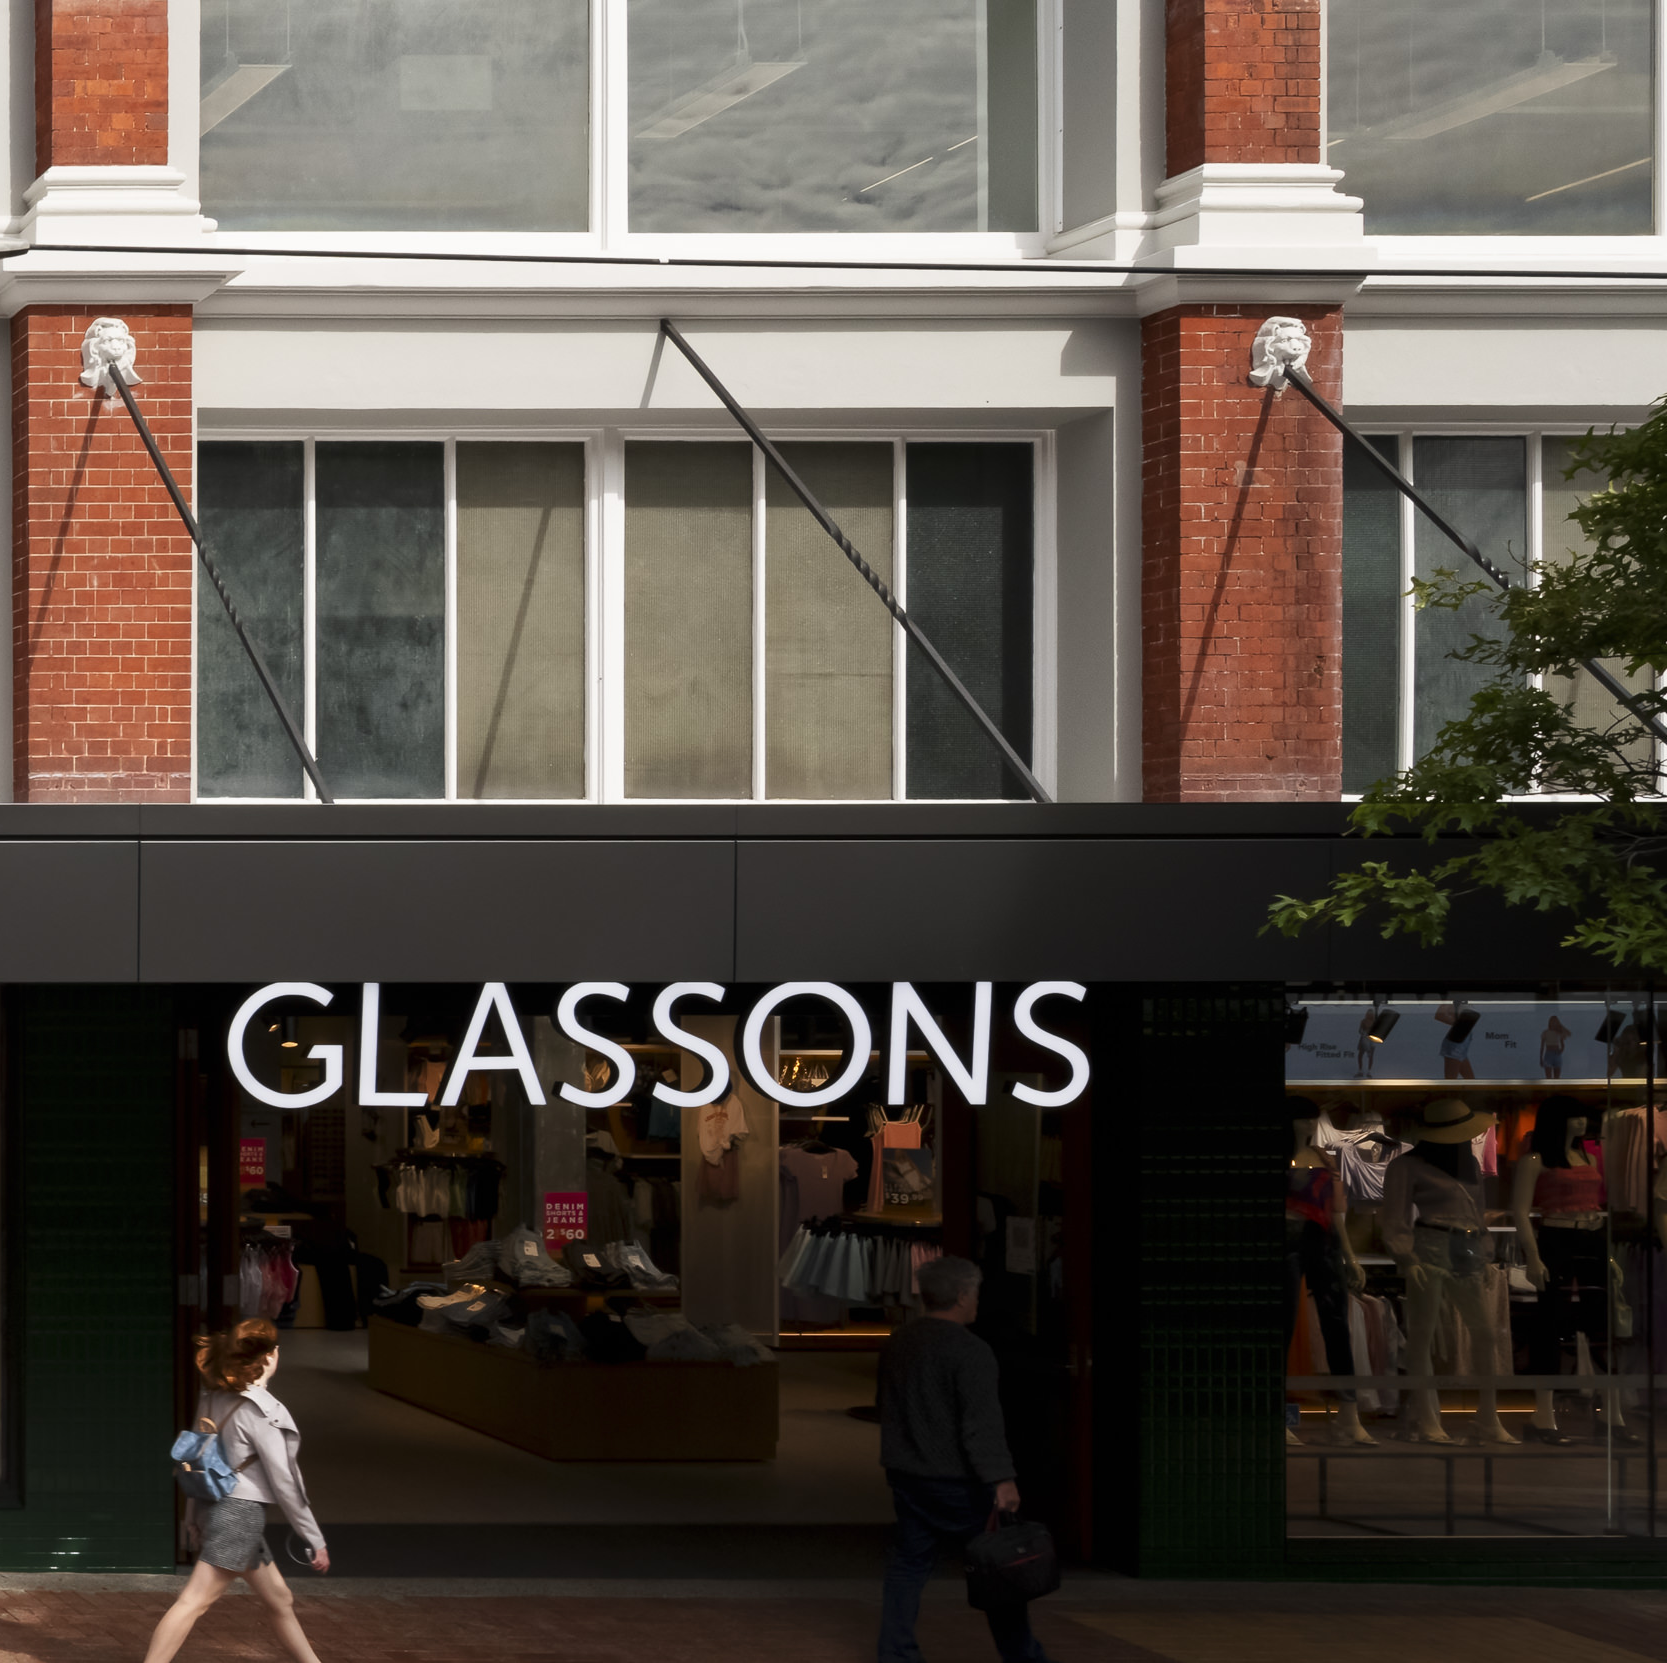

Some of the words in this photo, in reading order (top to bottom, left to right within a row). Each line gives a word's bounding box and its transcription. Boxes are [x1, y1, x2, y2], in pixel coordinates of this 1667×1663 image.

[1485, 1032, 1509, 1040] Mom
[228, 981, 1091, 1108] GLASSONS
[1505, 1041, 1517, 1049] Fit
[545, 1202, 585, 1211] DENIM
[546, 1216, 585, 1224] JEANS
[546, 1228, 555, 1240] 2
[559, 1227, 585, 1241] $60
